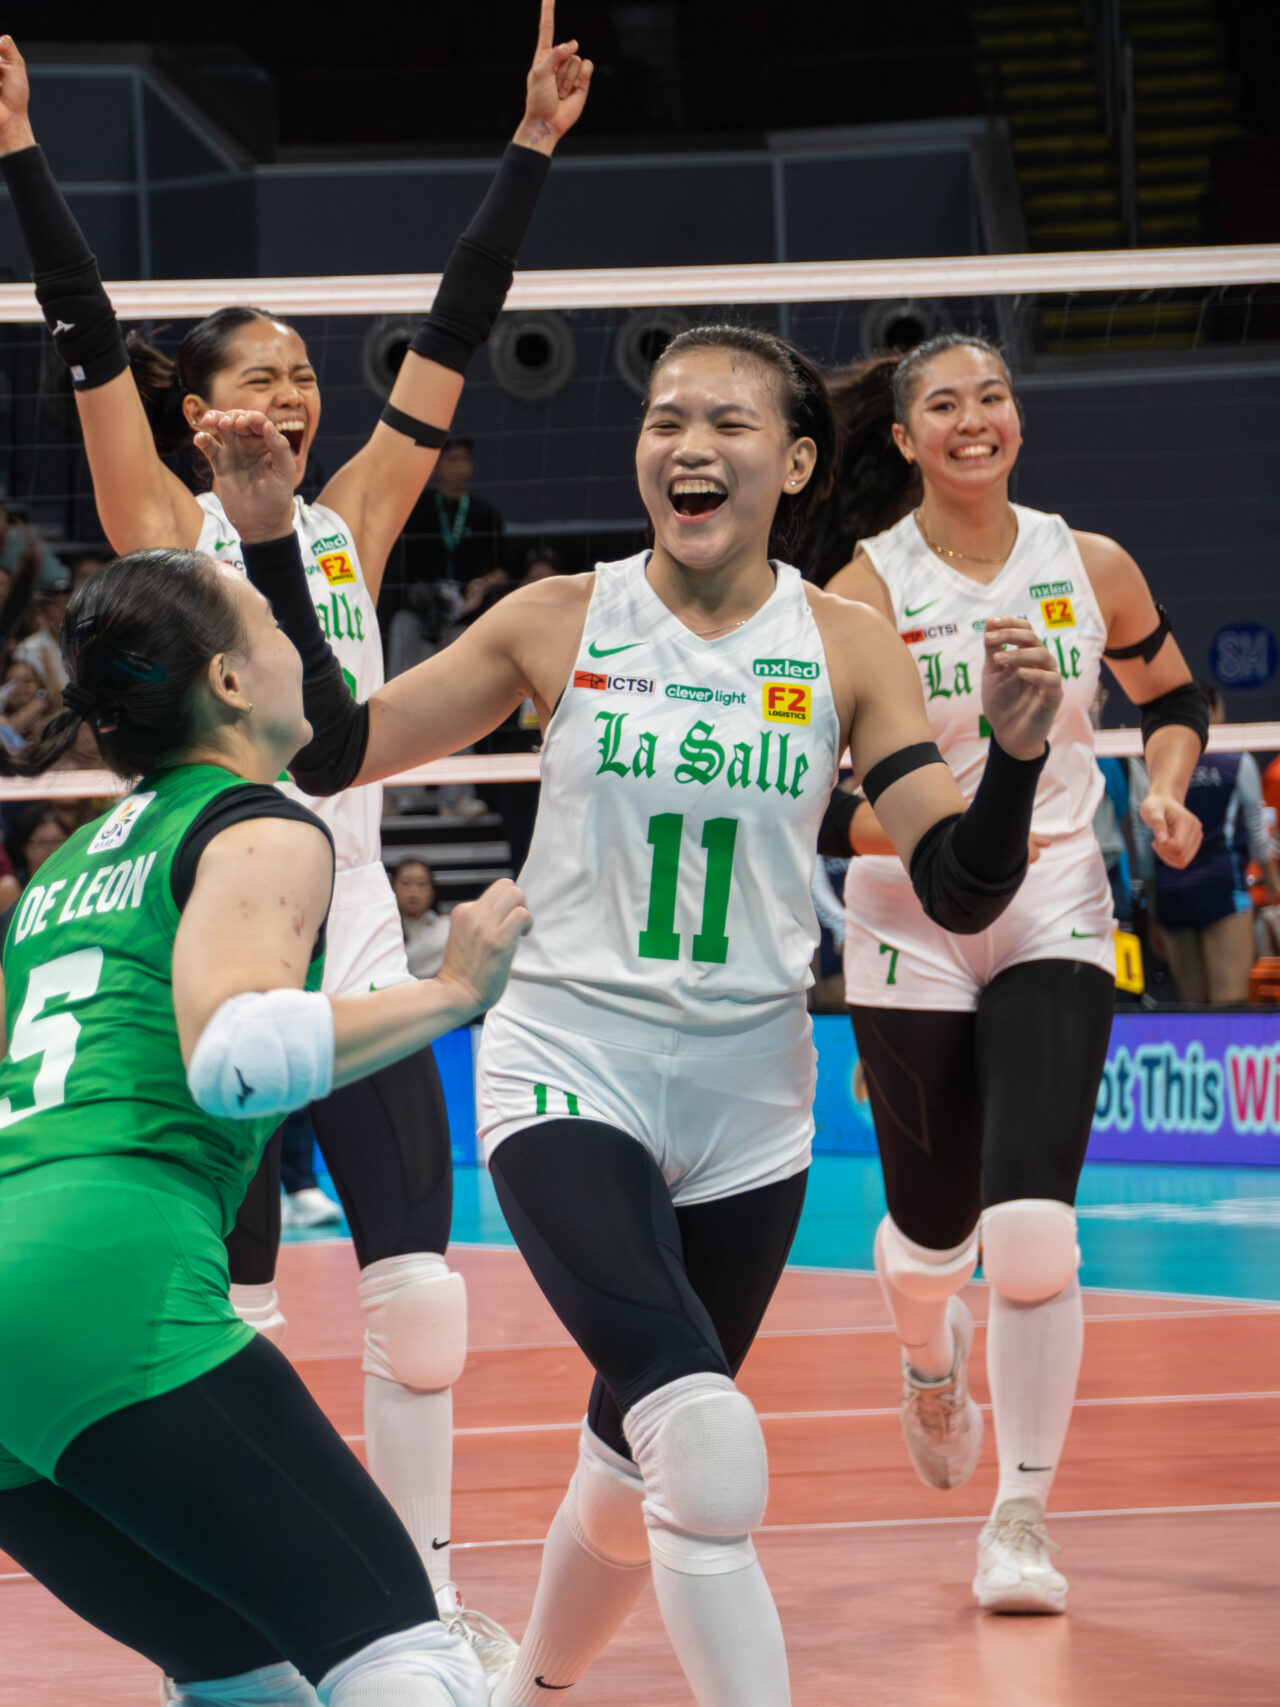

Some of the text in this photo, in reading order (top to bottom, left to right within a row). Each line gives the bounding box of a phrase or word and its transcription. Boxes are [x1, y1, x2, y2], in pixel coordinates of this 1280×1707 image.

[313, 533, 347, 555] xled
[320, 555, 351, 578] F2
[1030, 581, 1072, 598] nxled
[316, 591, 365, 642] alle
[1044, 601, 1071, 619] F2
[923, 624, 958, 639] ICTSI
[755, 660, 818, 679] nxled
[919, 651, 972, 701] La
[606, 676, 654, 694] ICTSI
[667, 685, 747, 706] clever light
[768, 686, 806, 713] F2
[768, 710, 806, 720] LOGISTICS
[594, 711, 810, 799] La Salle
[14, 851, 157, 946] DE LEON
[638, 812, 738, 964] 11
[878, 943, 899, 985] 7
[533, 1083, 580, 1116] 11
[1095, 1058, 1130, 1121] ot
[1140, 1052, 1219, 1122] This
